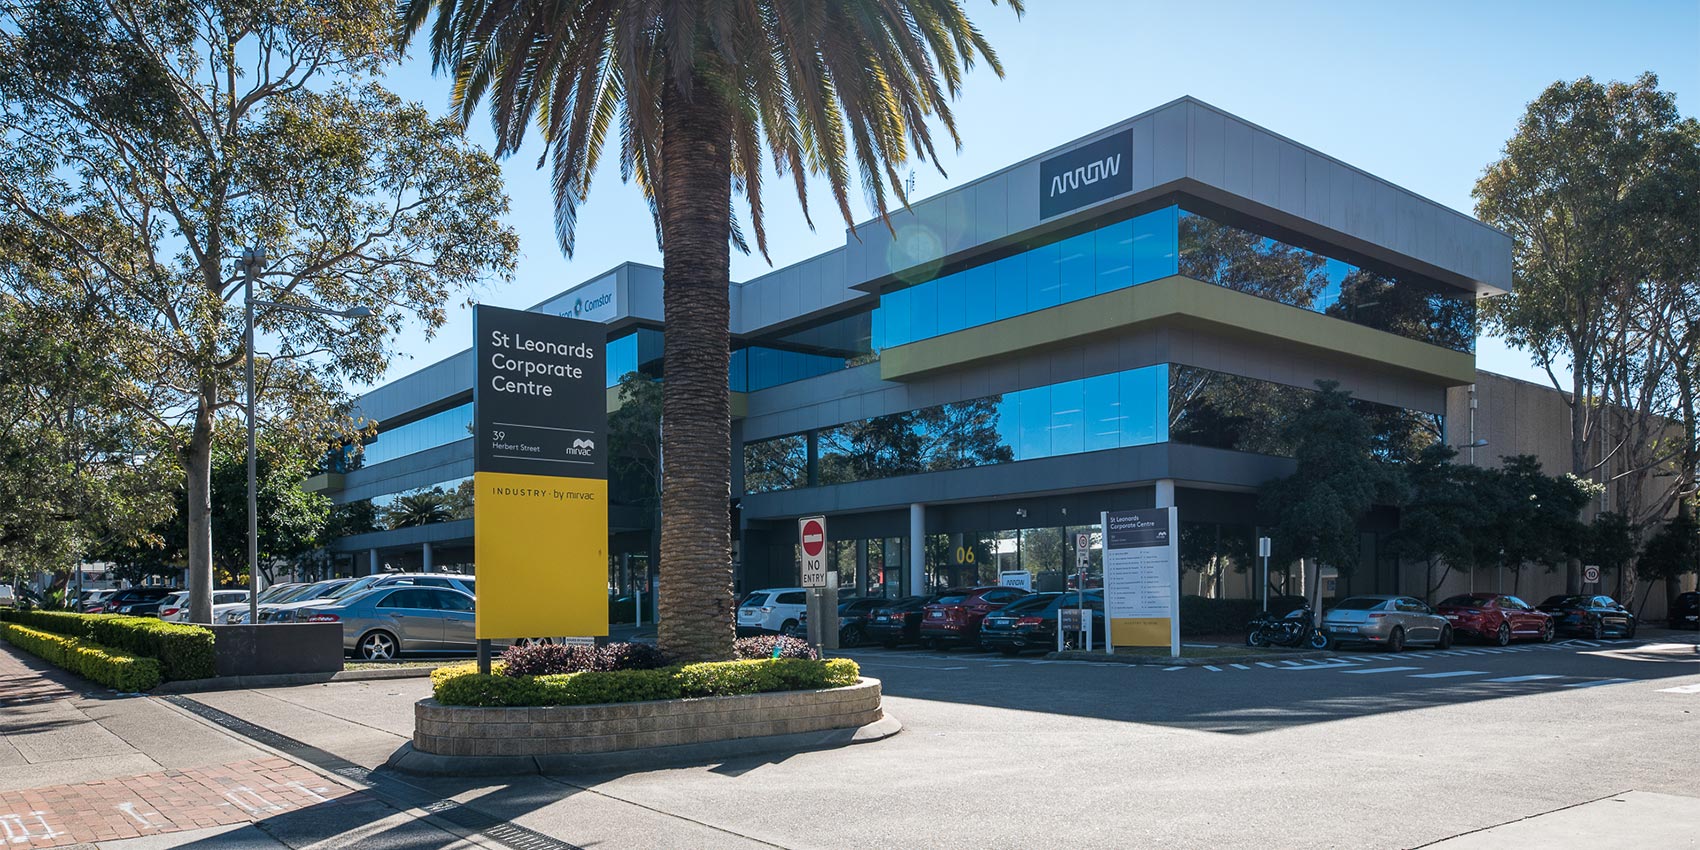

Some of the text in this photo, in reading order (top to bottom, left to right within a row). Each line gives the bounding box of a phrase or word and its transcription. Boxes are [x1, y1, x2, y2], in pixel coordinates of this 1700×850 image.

[1050, 153, 1120, 198] ARROW
[584, 293, 612, 313] Comstor
[491, 330, 594, 359] St Leonards
[491, 353, 583, 379] Corporate
[491, 375, 553, 397] Centre
[492, 430, 506, 441] 39
[492, 442, 541, 453] Herbert Street
[565, 447, 591, 456] mirvac
[492, 487, 595, 500] INDUSTRY by mirvac
[1116, 515, 1139, 523] Leonards
[1110, 522, 1136, 530] Corporate
[956, 546, 975, 564] 06
[807, 559, 820, 571] NO
[803, 573, 825, 583] ENTRY
